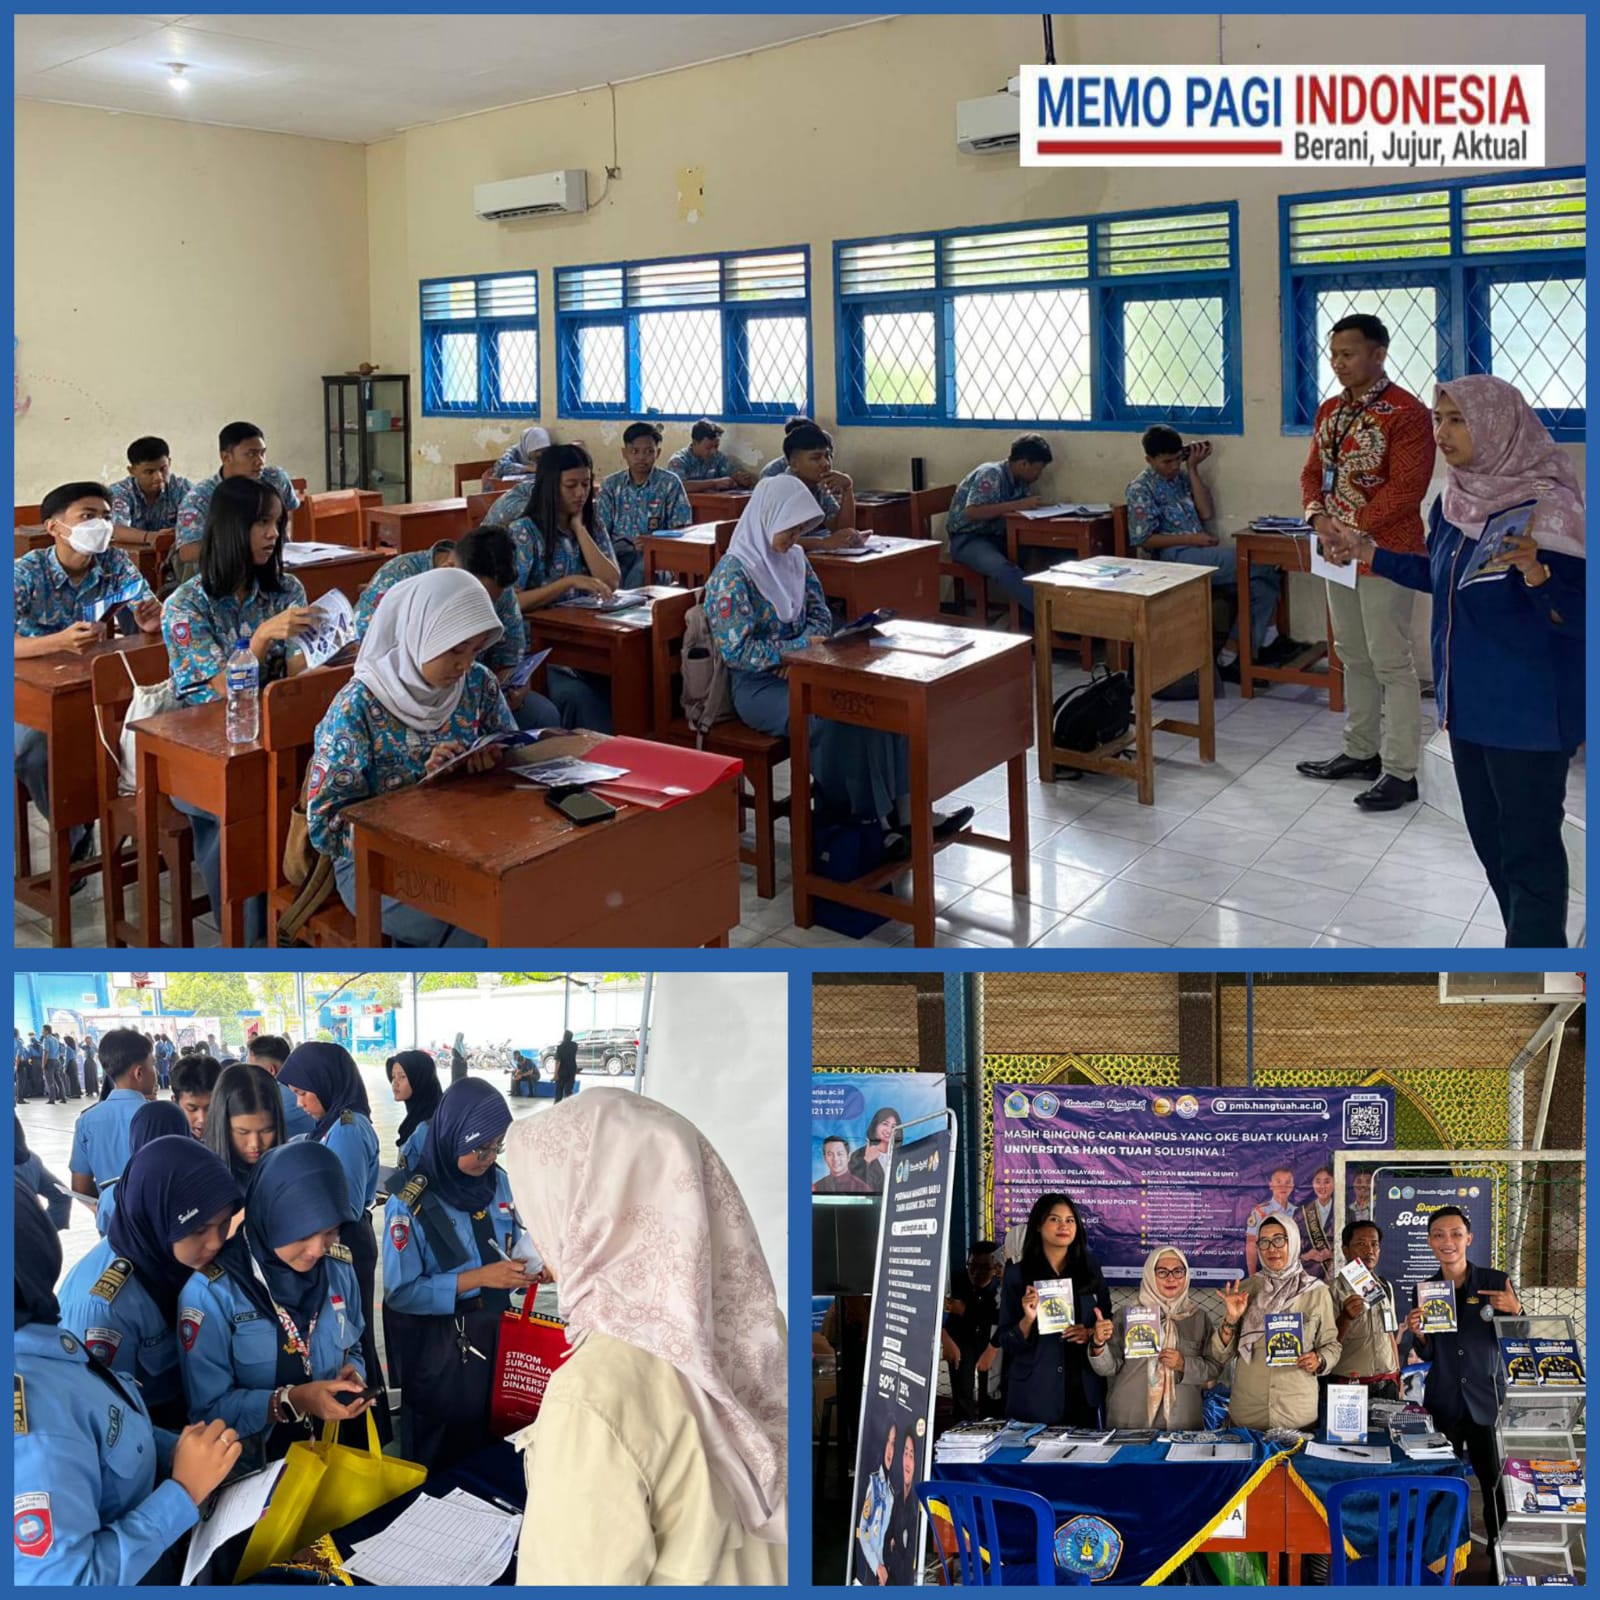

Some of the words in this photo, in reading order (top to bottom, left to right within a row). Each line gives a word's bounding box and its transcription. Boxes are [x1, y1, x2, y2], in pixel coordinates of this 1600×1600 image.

[825, 1107, 845, 1115] 2117
[1229, 1102, 1322, 1112] pmb.hangtuah.ac.id
[1004, 1130, 1040, 1139] MASIH
[1043, 1130, 1096, 1140] BINGUNG
[1098, 1131, 1126, 1140] CARI
[1128, 1131, 1177, 1141] KAMPUS
[1180, 1132, 1212, 1141] YANG
[1215, 1132, 1239, 1142] OKE
[1242, 1133, 1273, 1142] BUAT
[1276, 1133, 1319, 1142] KULIAH
[1004, 1145, 1080, 1154] UNIVERSITAS
[1082, 1145, 1116, 1155] HANG
[1119, 1146, 1151, 1156] TUAH
[1154, 1147, 1219, 1157] SOLUSINYA
[506, 1351, 541, 1364] STIKOM
[505, 1359, 552, 1375] SURABAYA
[503, 1372, 548, 1388] UNIVERSI
[502, 1380, 544, 1396] DINAMIK
